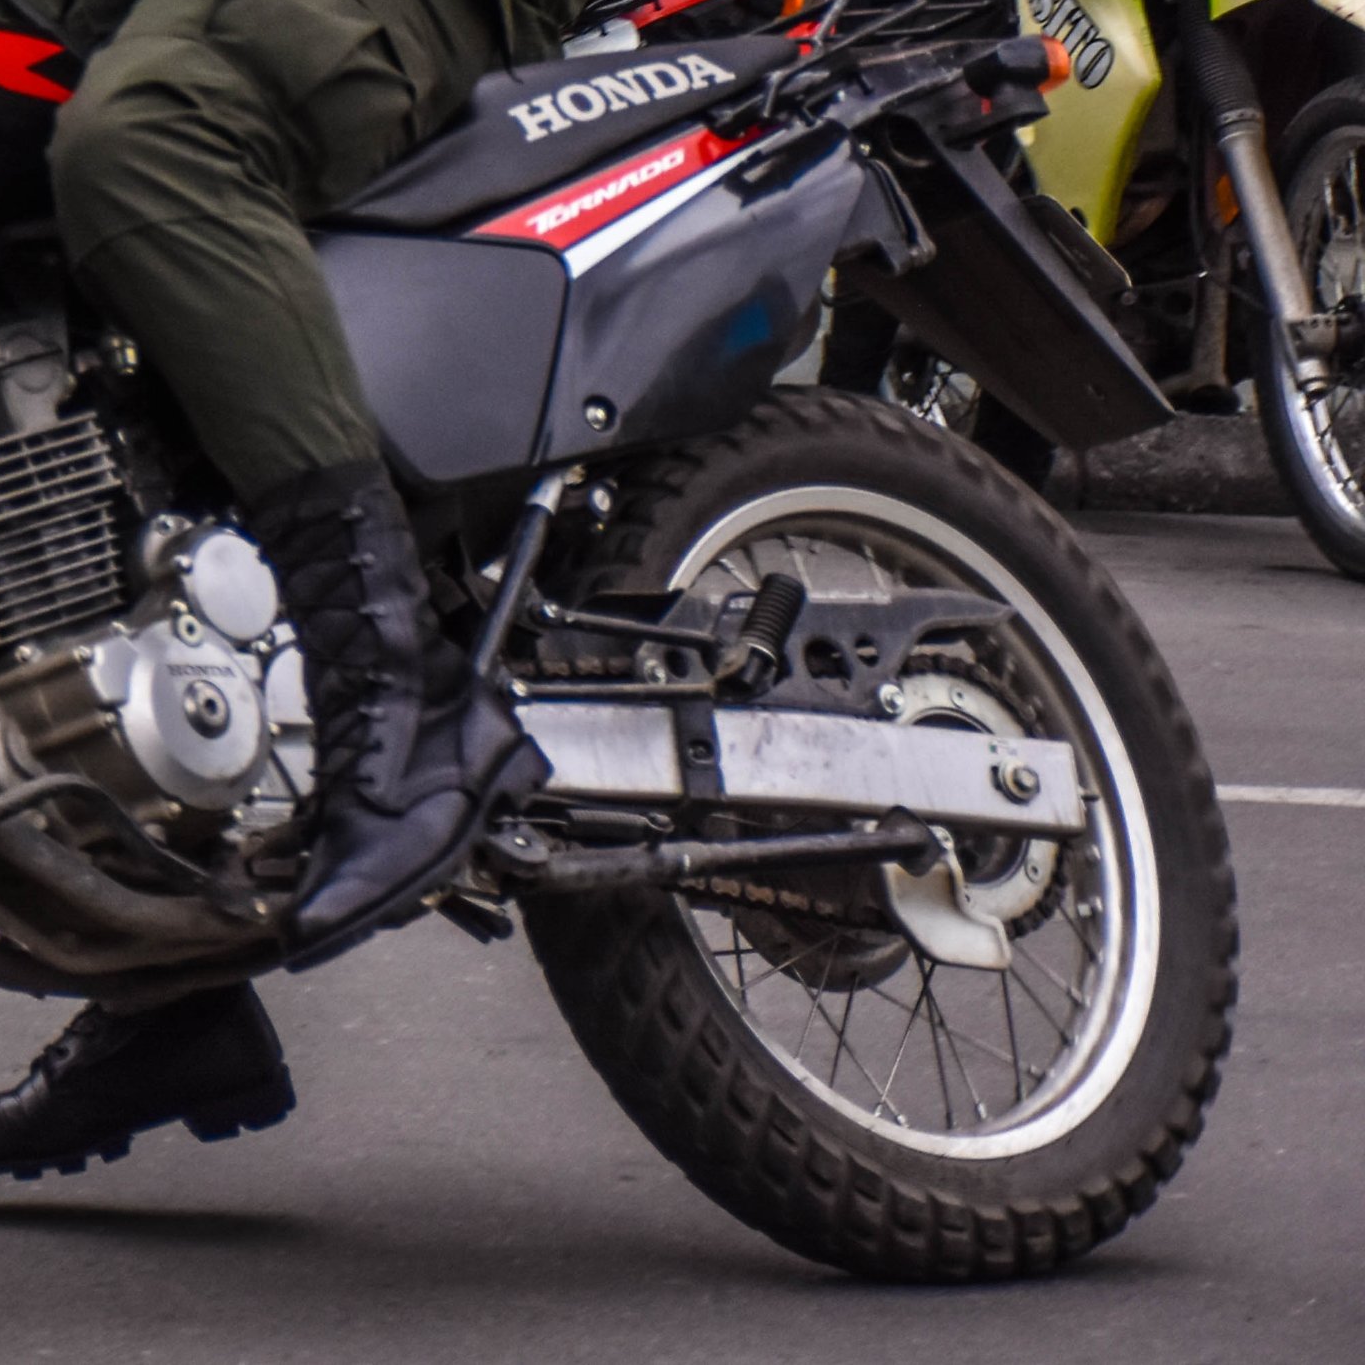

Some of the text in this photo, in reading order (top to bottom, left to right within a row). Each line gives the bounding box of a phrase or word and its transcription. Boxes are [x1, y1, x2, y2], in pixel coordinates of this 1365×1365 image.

[507, 53, 737, 142] HONDA
[525, 148, 686, 235] TORNADO
[166, 663, 237, 678] HONDA
